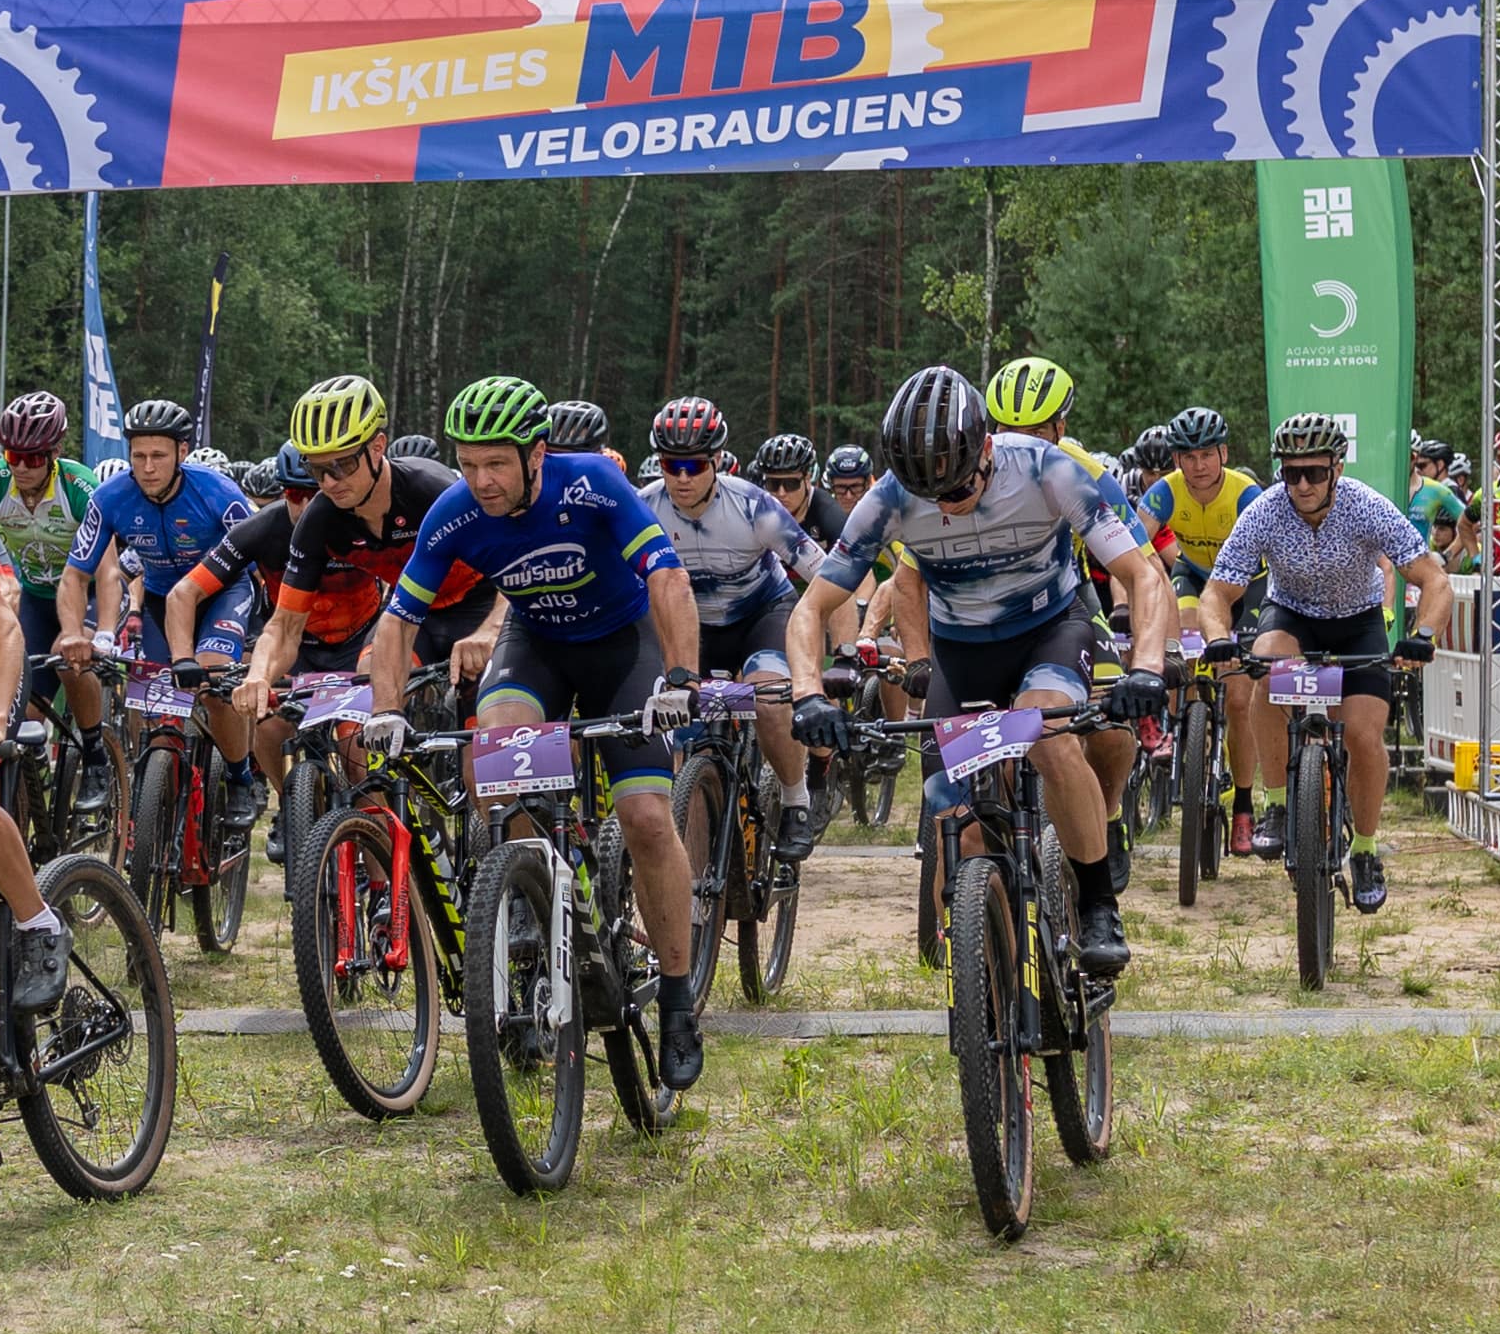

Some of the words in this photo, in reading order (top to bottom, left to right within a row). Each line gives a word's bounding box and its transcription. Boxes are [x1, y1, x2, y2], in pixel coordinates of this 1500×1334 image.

[309, 48, 548, 116] IKŠĶILES
[498, 87, 964, 170] VELOBRAUCIENS
[502, 556, 587, 588] mySport
[1292, 676, 1319, 695] 15
[980, 725, 1004, 748] 3
[512, 751, 534, 777] 2
